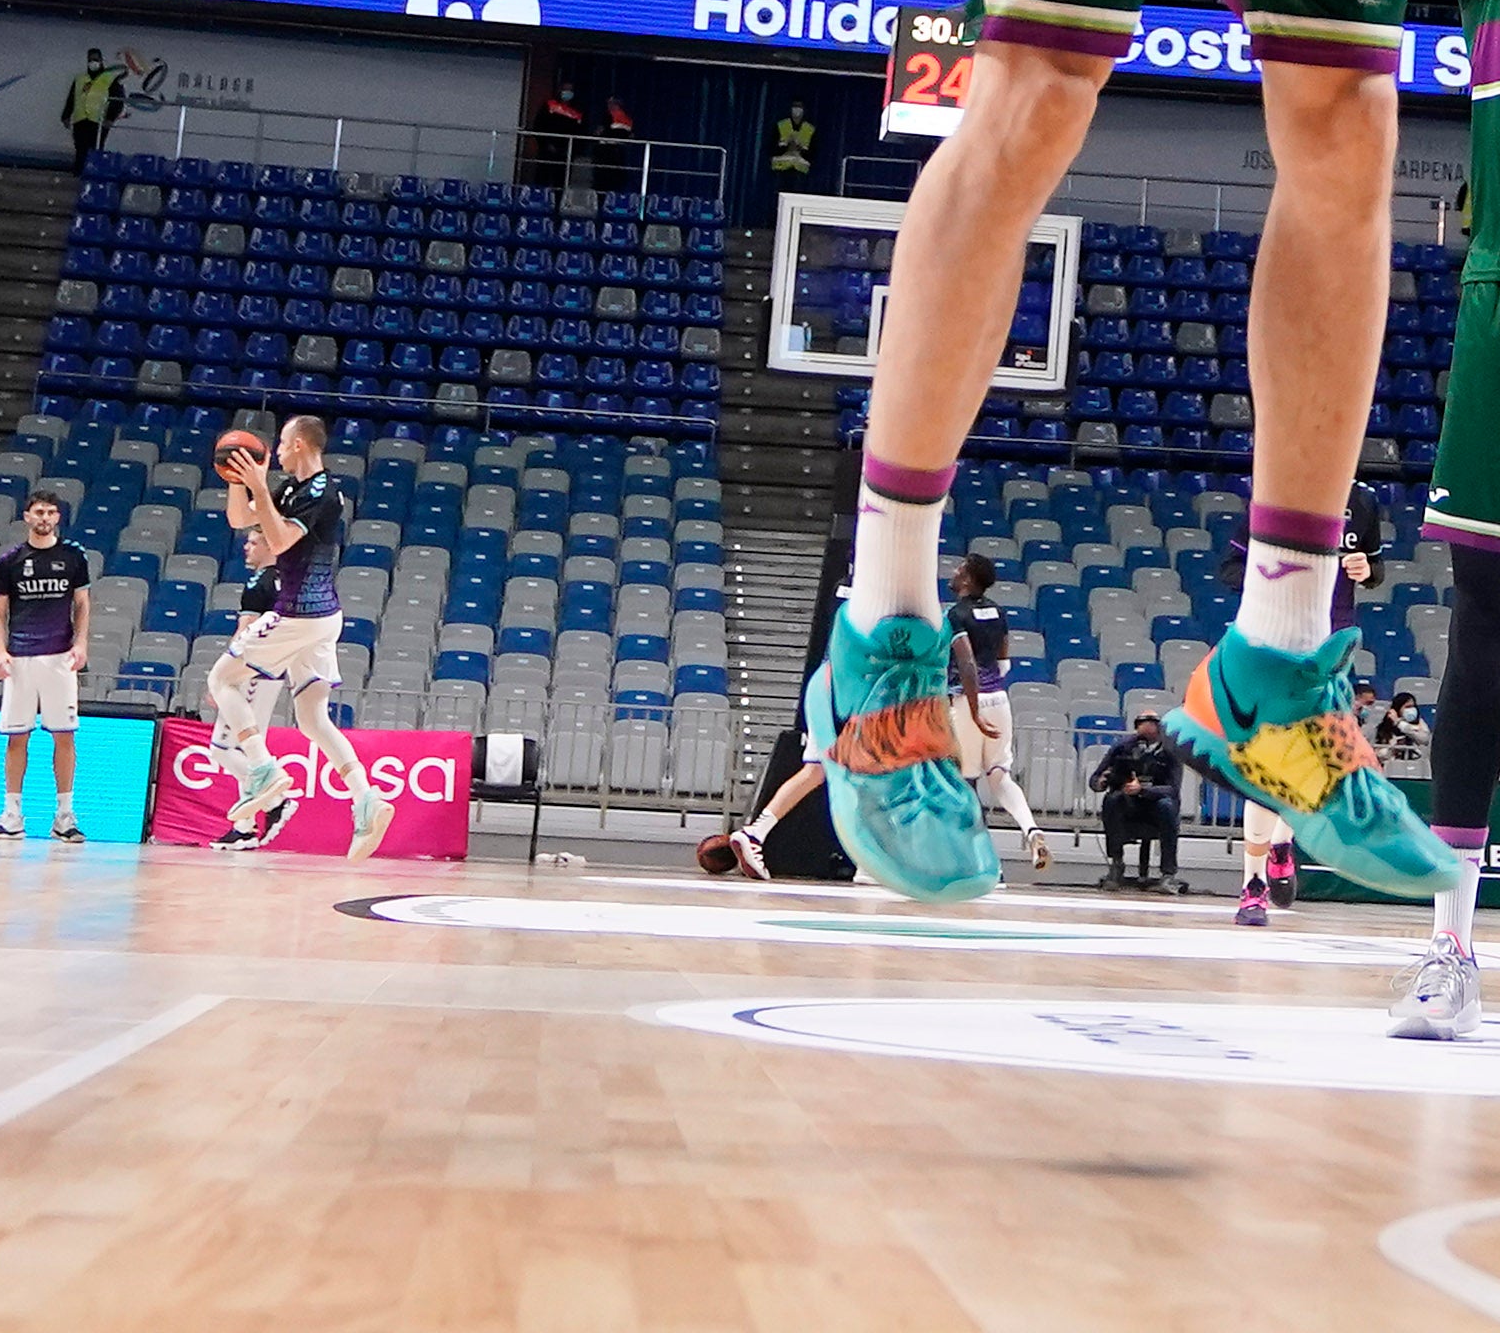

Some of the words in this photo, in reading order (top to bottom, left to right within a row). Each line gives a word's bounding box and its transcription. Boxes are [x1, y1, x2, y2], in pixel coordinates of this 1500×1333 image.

[903, 51, 972, 107] 24
[17, 577, 69, 594] surne
[173, 740, 455, 802] edesa
